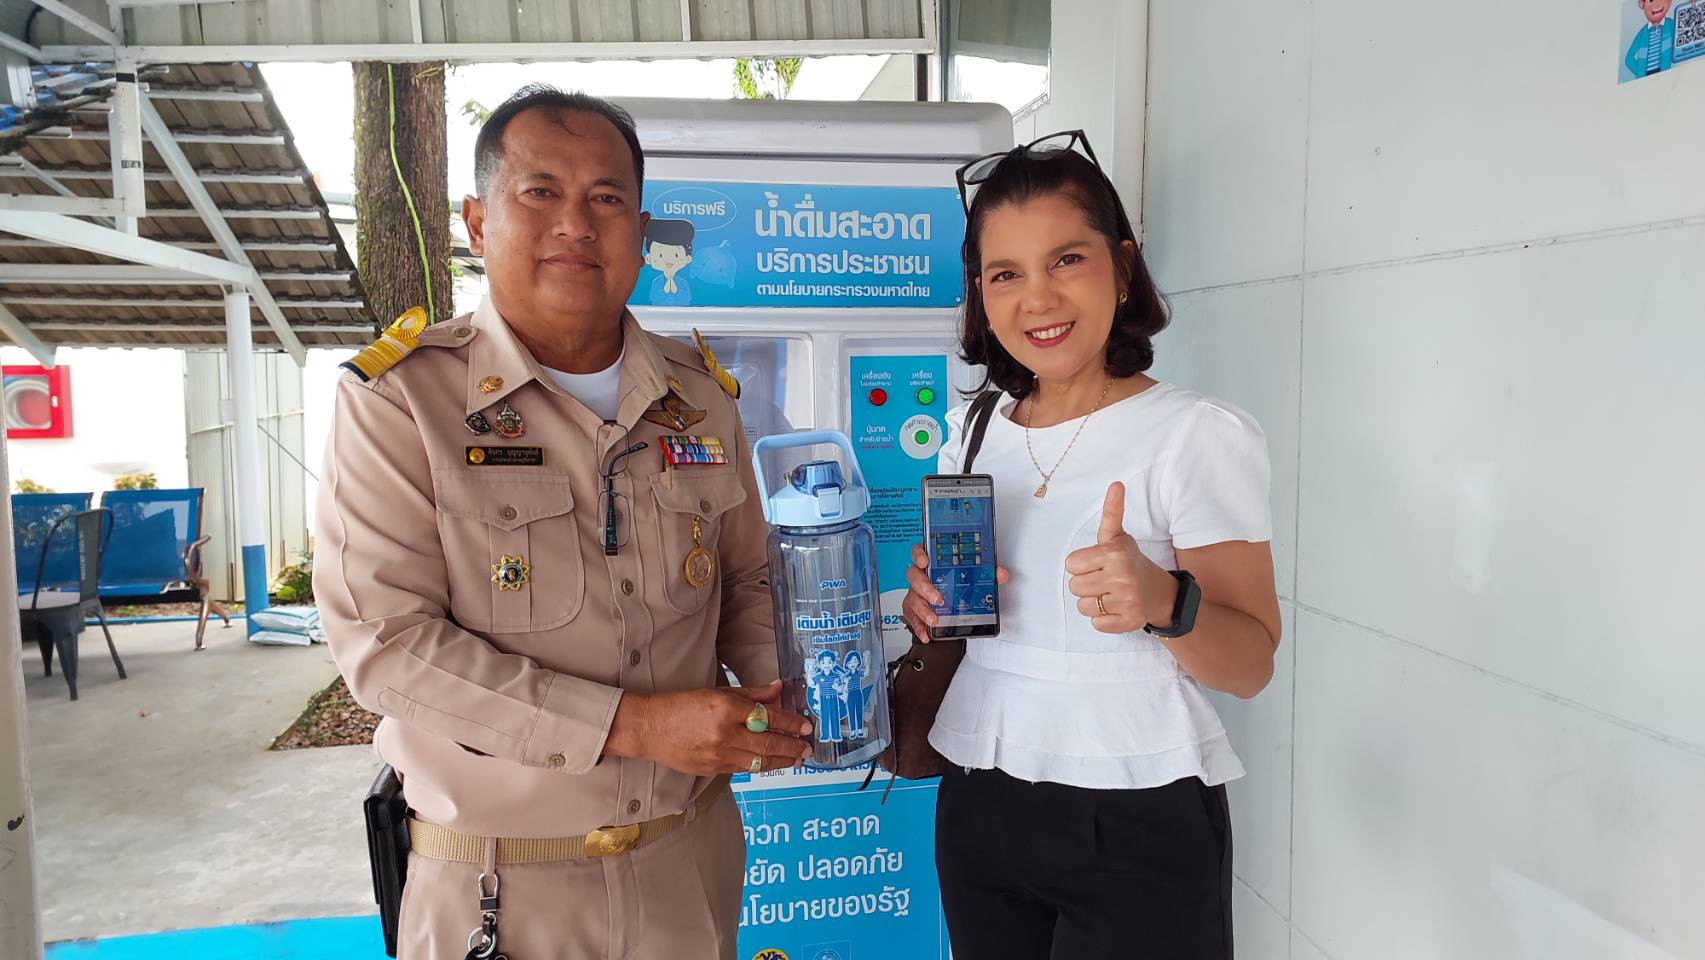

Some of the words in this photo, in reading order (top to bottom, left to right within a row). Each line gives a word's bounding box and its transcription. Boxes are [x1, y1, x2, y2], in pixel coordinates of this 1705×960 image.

[663, 199, 726, 216] บริการฟรี
[755, 192, 931, 240] น้ำดื่มสะอาด
[756, 248, 930, 276] บริการประชาชน
[756, 280, 931, 297] ตามนโยบายกระทรวงมหาดไทย
[820, 579, 847, 590] PWA
[796, 611, 835, 630] เติมน้ำ
[836, 609, 872, 630] เติมสุข
[802, 814, 880, 841] สะอาด
[744, 858, 785, 886] ยัด
[798, 847, 903, 881] ปลอดภัย
